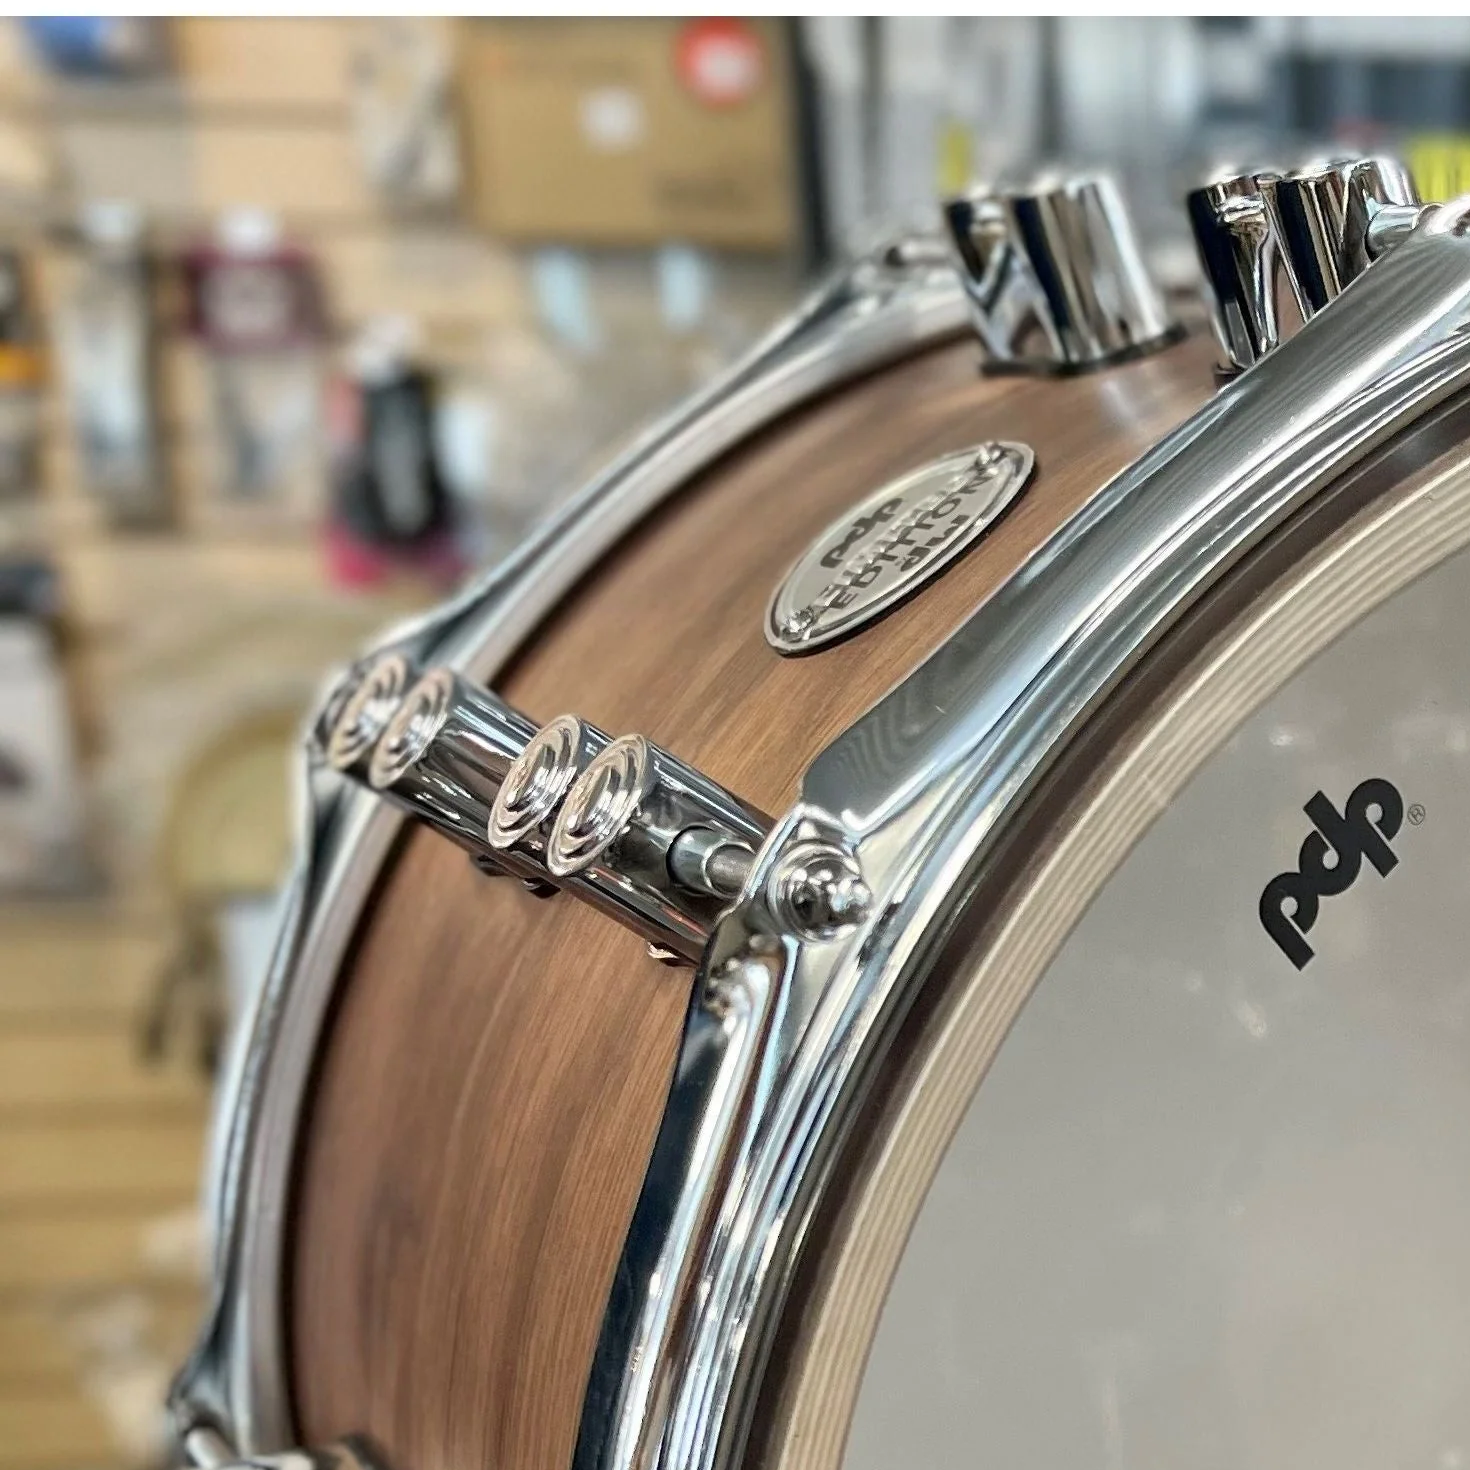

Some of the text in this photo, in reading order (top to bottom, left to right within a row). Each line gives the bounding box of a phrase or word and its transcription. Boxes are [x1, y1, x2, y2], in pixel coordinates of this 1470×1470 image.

[820, 498, 903, 568] pdp
[829, 474, 993, 609] EDITION
[900, 515, 969, 572] dw
[1259, 778, 1403, 971] pdp
